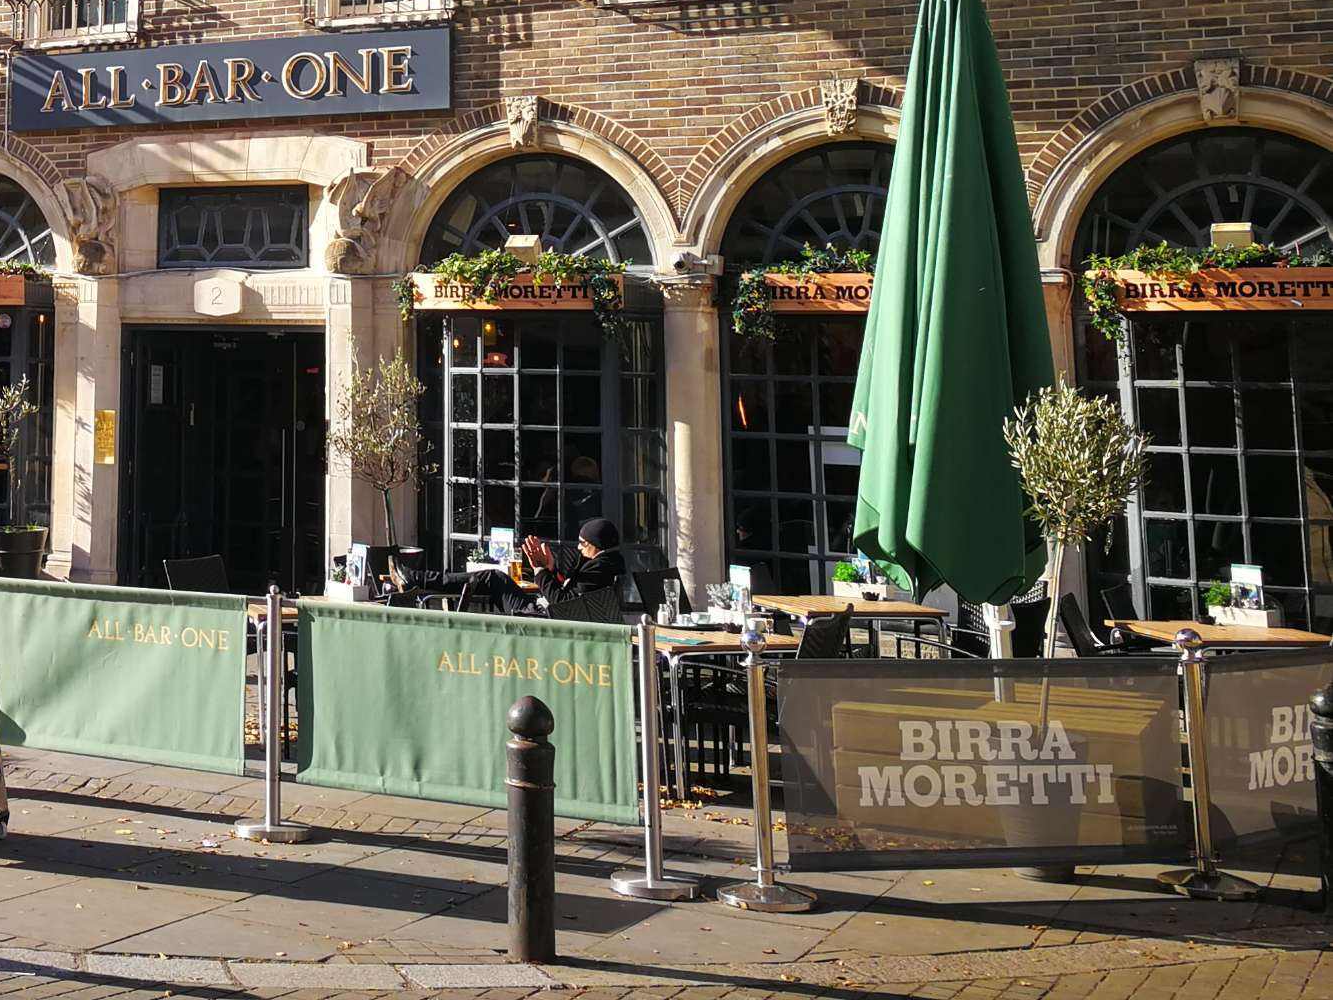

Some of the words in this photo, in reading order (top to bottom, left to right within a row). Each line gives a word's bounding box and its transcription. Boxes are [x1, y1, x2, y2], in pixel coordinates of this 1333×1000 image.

[41, 66, 135, 112] ALL
[154, 57, 264, 108] BAR
[281, 45, 413, 100] ONE
[211, 286, 223, 305] 2
[434, 285, 474, 299] BIRR
[770, 285, 827, 300] IRRA
[834, 285, 874, 300] MO
[1125, 282, 1206, 299] BIRRA
[1215, 280, 1333, 298] MORETT
[87, 617, 124, 641] ALL
[134, 623, 172, 646] BAR
[181, 627, 230, 651] ONE
[437, 650, 482, 675] ALL
[493, 655, 543, 681] BAR
[552, 659, 612, 687] ONE
[898, 720, 1077, 762] BIRRA
[857, 764, 1116, 808] MORETTI
